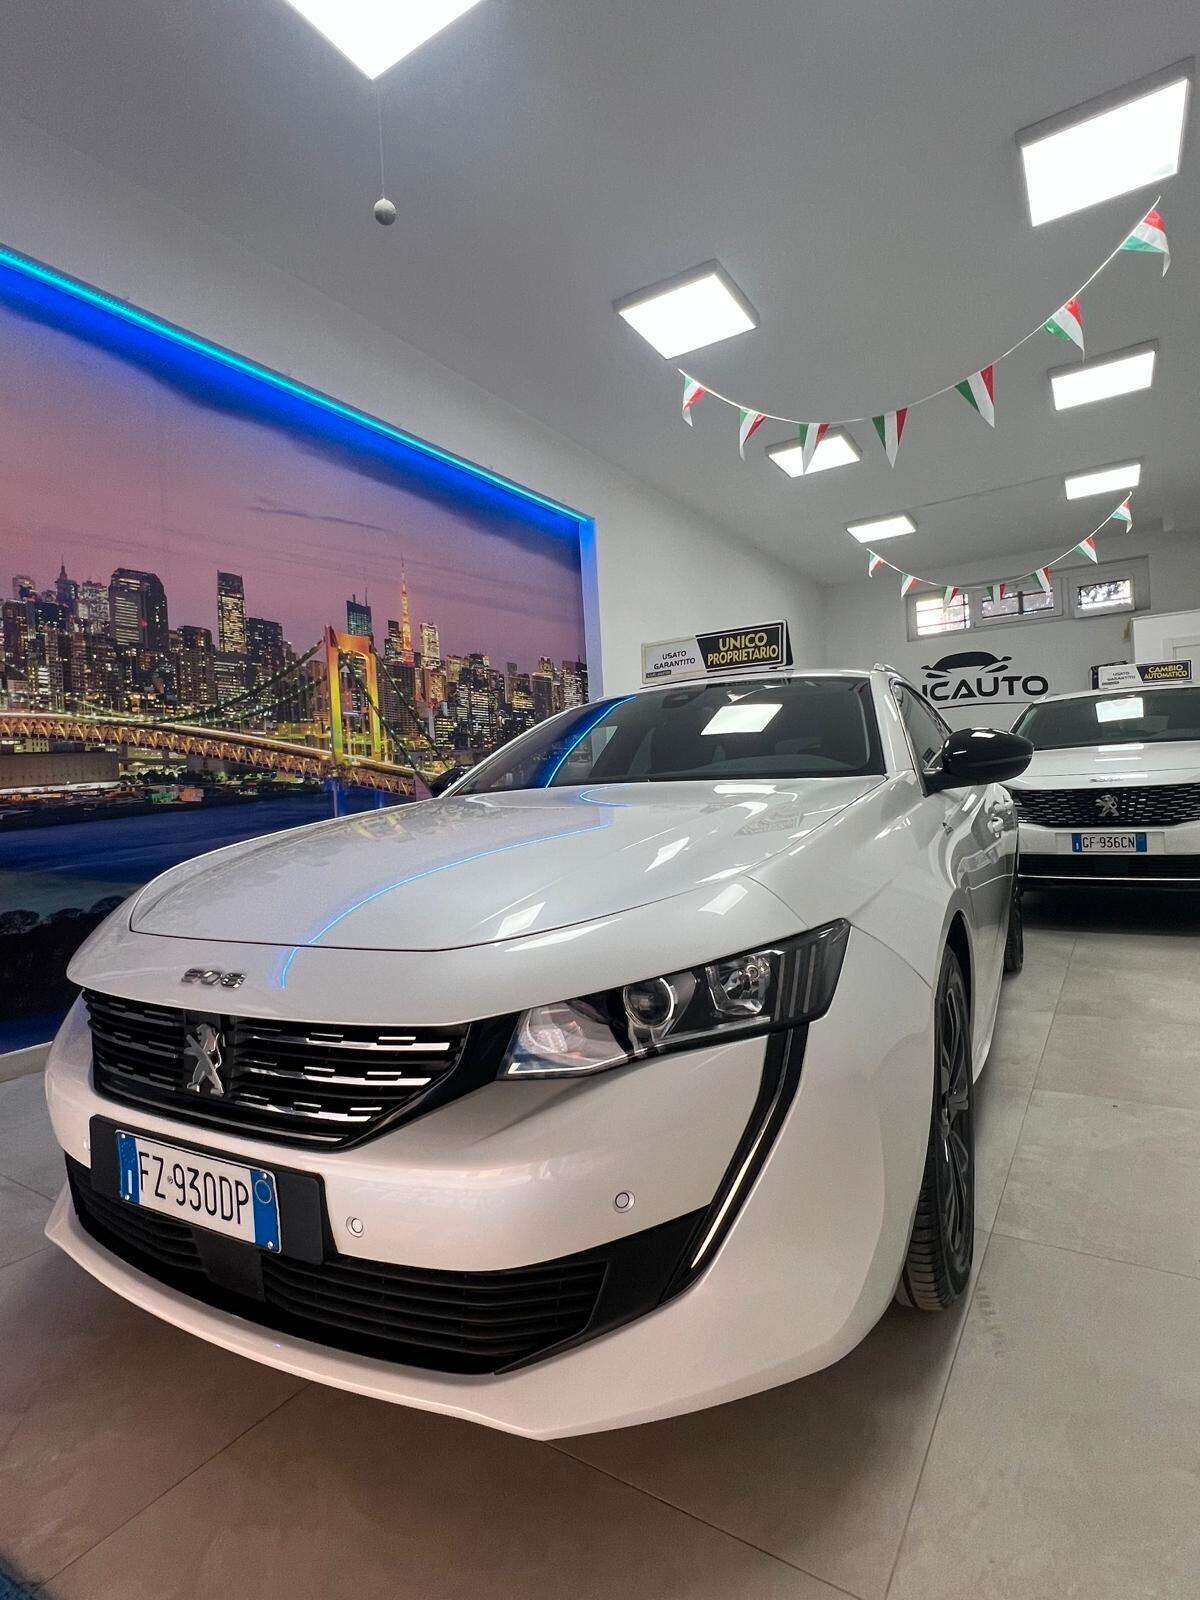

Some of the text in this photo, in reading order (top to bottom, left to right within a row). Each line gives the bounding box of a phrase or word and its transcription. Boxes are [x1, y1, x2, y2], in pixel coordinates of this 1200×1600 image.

[719, 632, 767, 651] UNICO
[662, 650, 687, 660] USATO
[707, 645, 779, 666] PROPRIETARIO
[653, 657, 696, 670] GARANTITO
[1148, 664, 1184, 674] CAMBIO
[1143, 670, 1188, 680] AUTOMATICO
